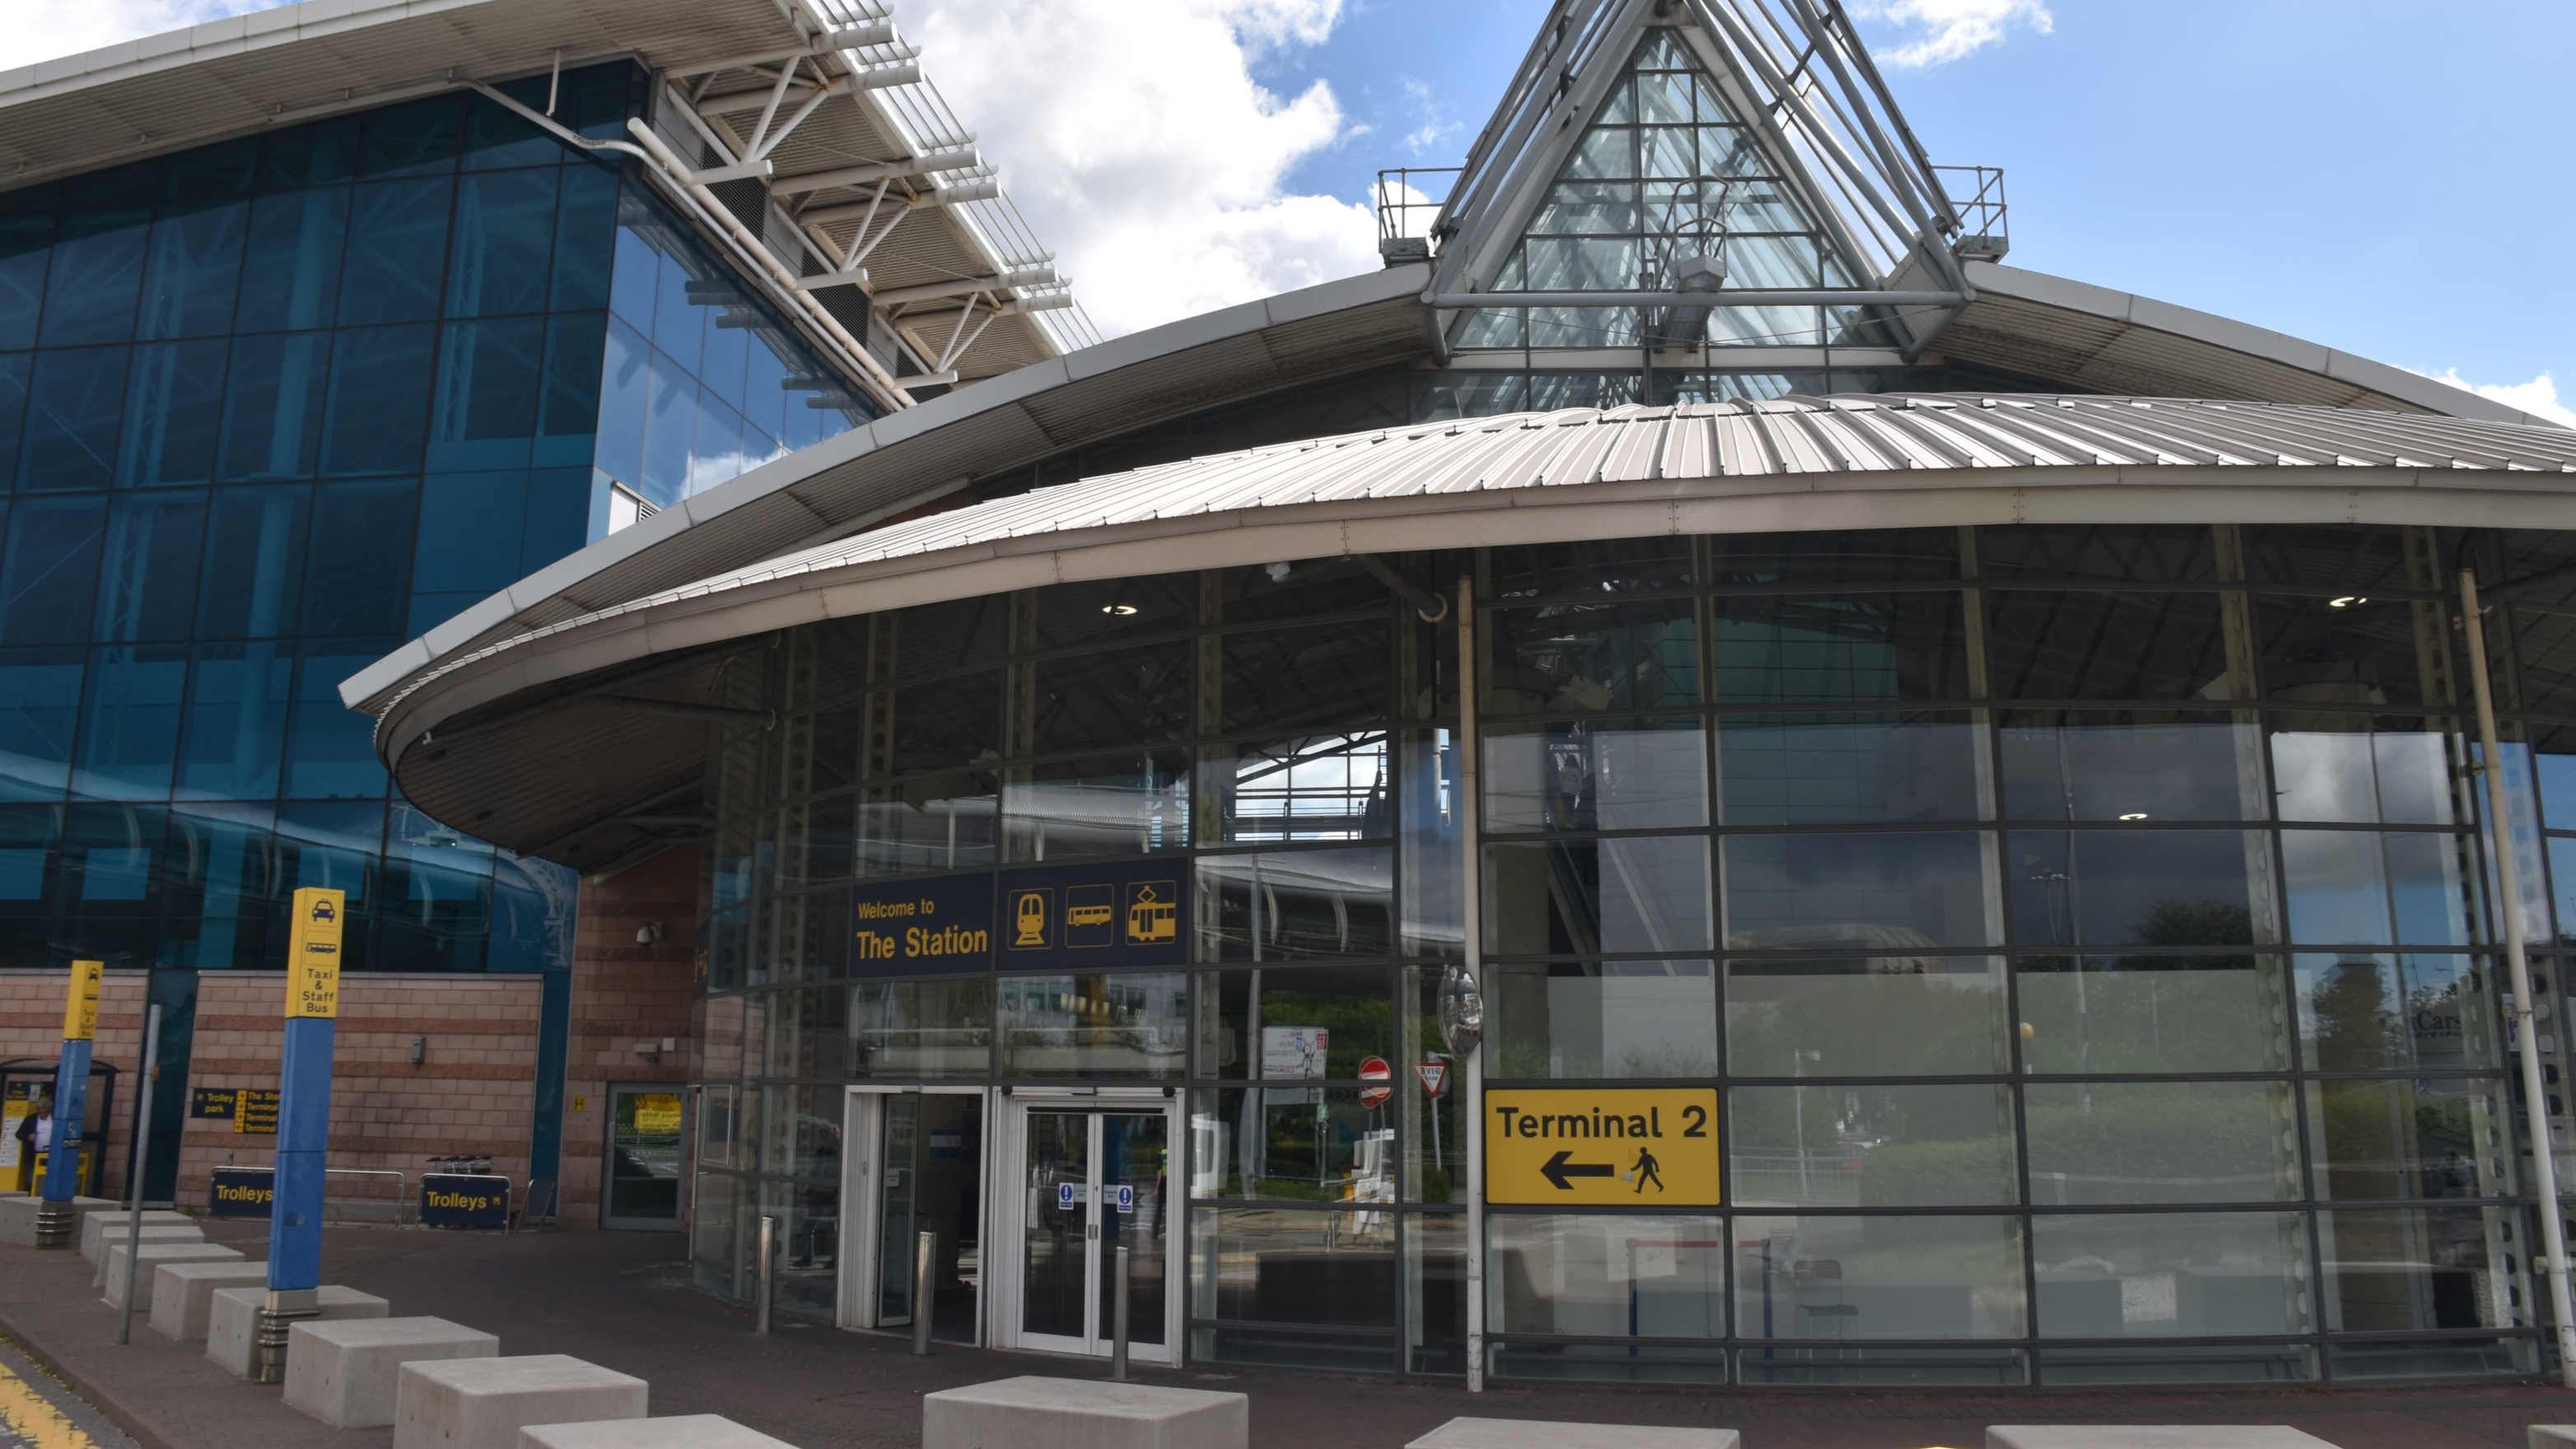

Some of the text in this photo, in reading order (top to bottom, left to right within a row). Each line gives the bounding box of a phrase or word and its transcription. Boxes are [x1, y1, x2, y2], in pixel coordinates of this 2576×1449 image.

[858, 898, 935, 920] Welcome to
[856, 925, 987, 959] The Station
[307, 968, 333, 980] Taxi
[315, 980, 323, 990] &
[302, 990, 334, 1002] Staff
[306, 1002, 329, 1013] Bus
[207, 1093, 234, 1104] Trolley
[248, 1092, 280, 1101] The Sta
[204, 1105, 224, 1114] park
[248, 1103, 278, 1111] Terminal
[247, 1113, 278, 1121] Terminal
[1496, 1105, 1706, 1138] Terminal 2
[245, 1124, 277, 1132] Terminal
[216, 1185, 273, 1204] Trolleys
[427, 1191, 487, 1211] Trolleys
